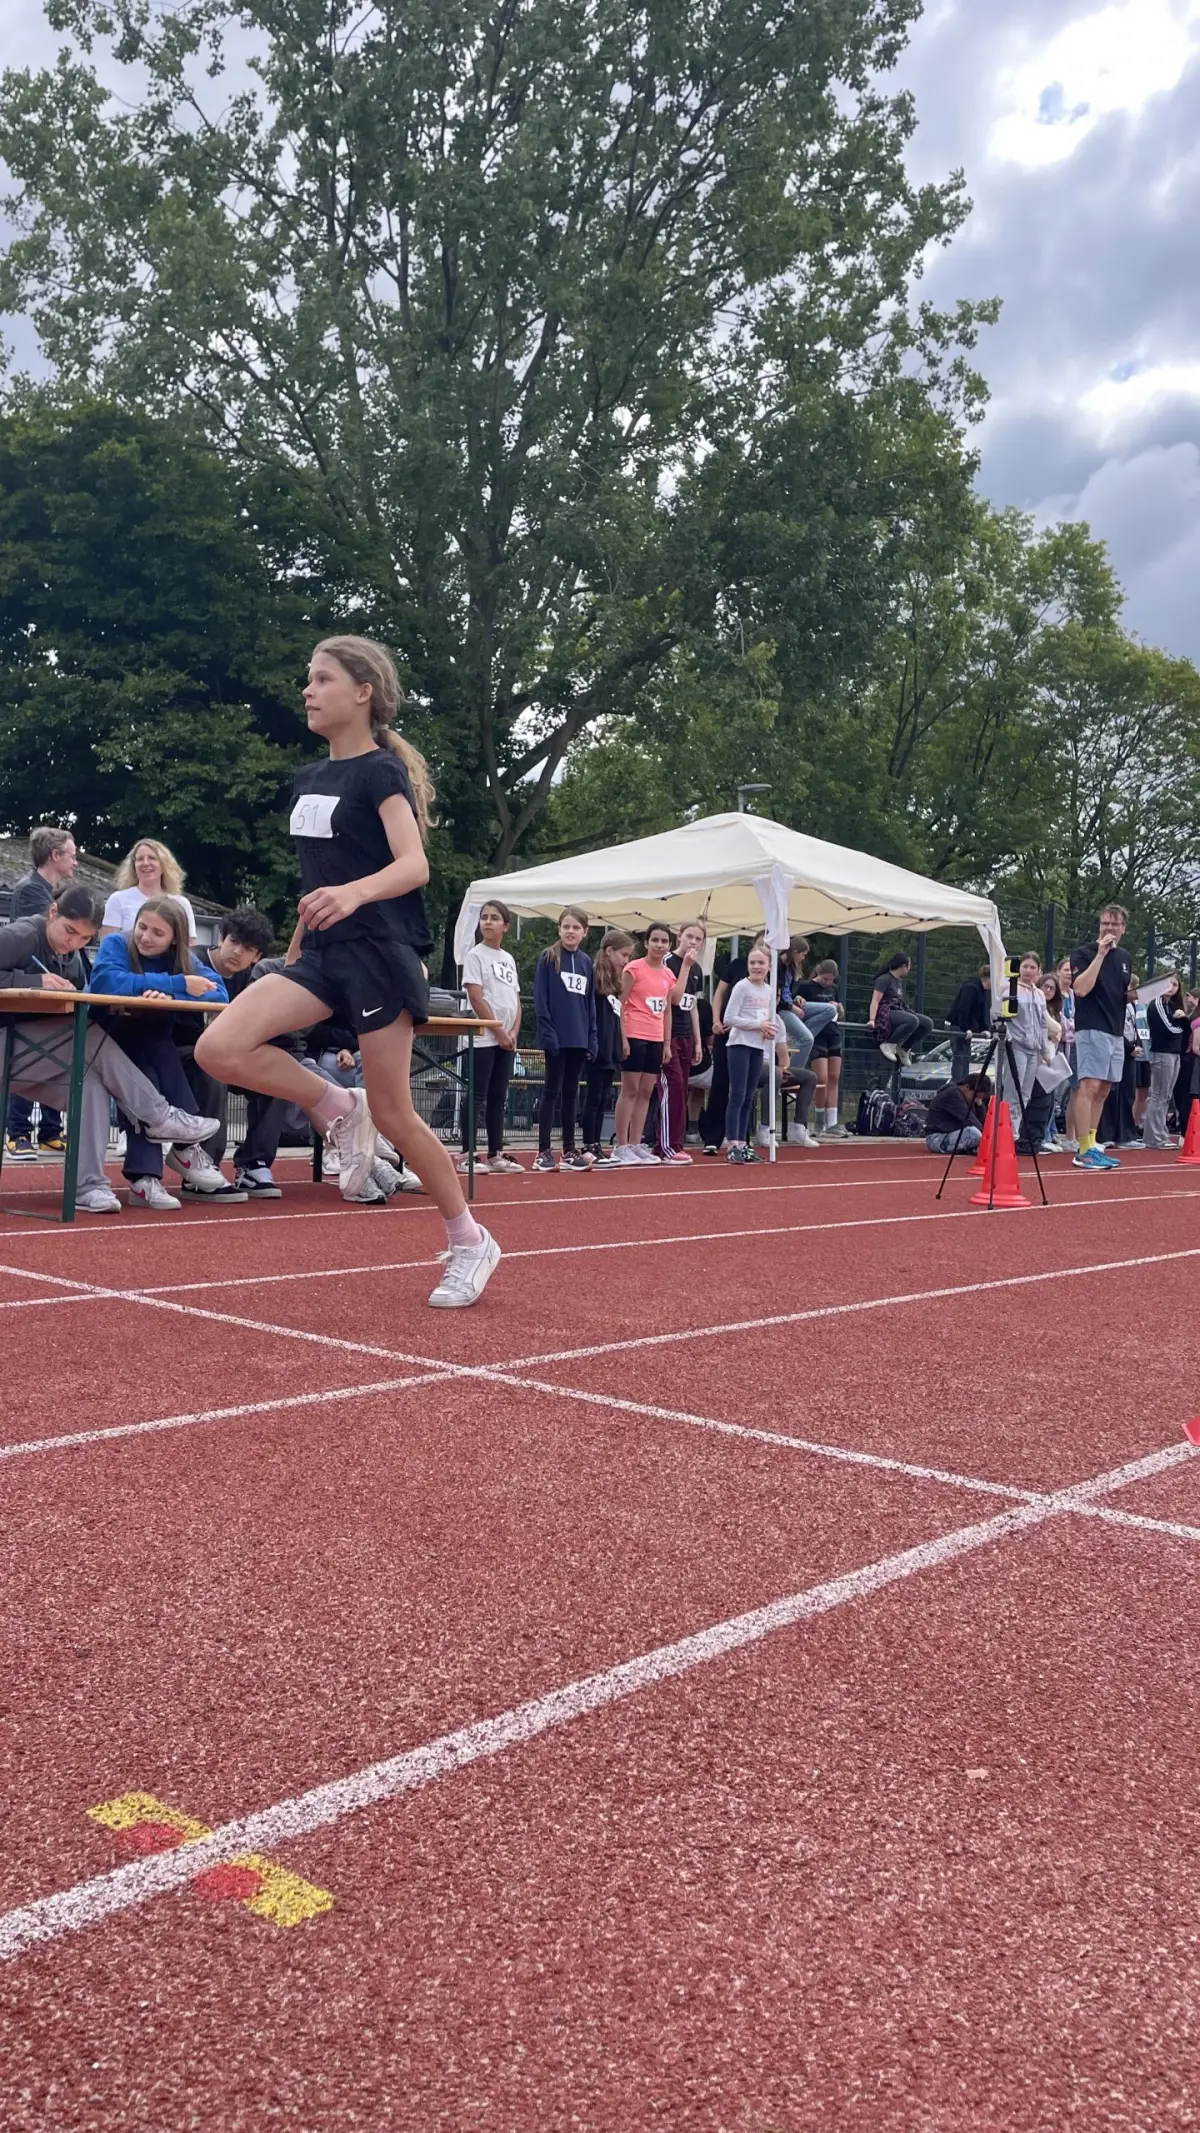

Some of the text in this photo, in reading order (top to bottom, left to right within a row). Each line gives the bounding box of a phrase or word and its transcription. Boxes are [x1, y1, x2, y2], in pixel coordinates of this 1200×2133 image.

[295, 804, 320, 831] 51
[500, 967, 513, 983] 16
[568, 976, 582, 990] 18
[652, 999, 663, 1012] 15
[681, 996, 693, 1009] 13
